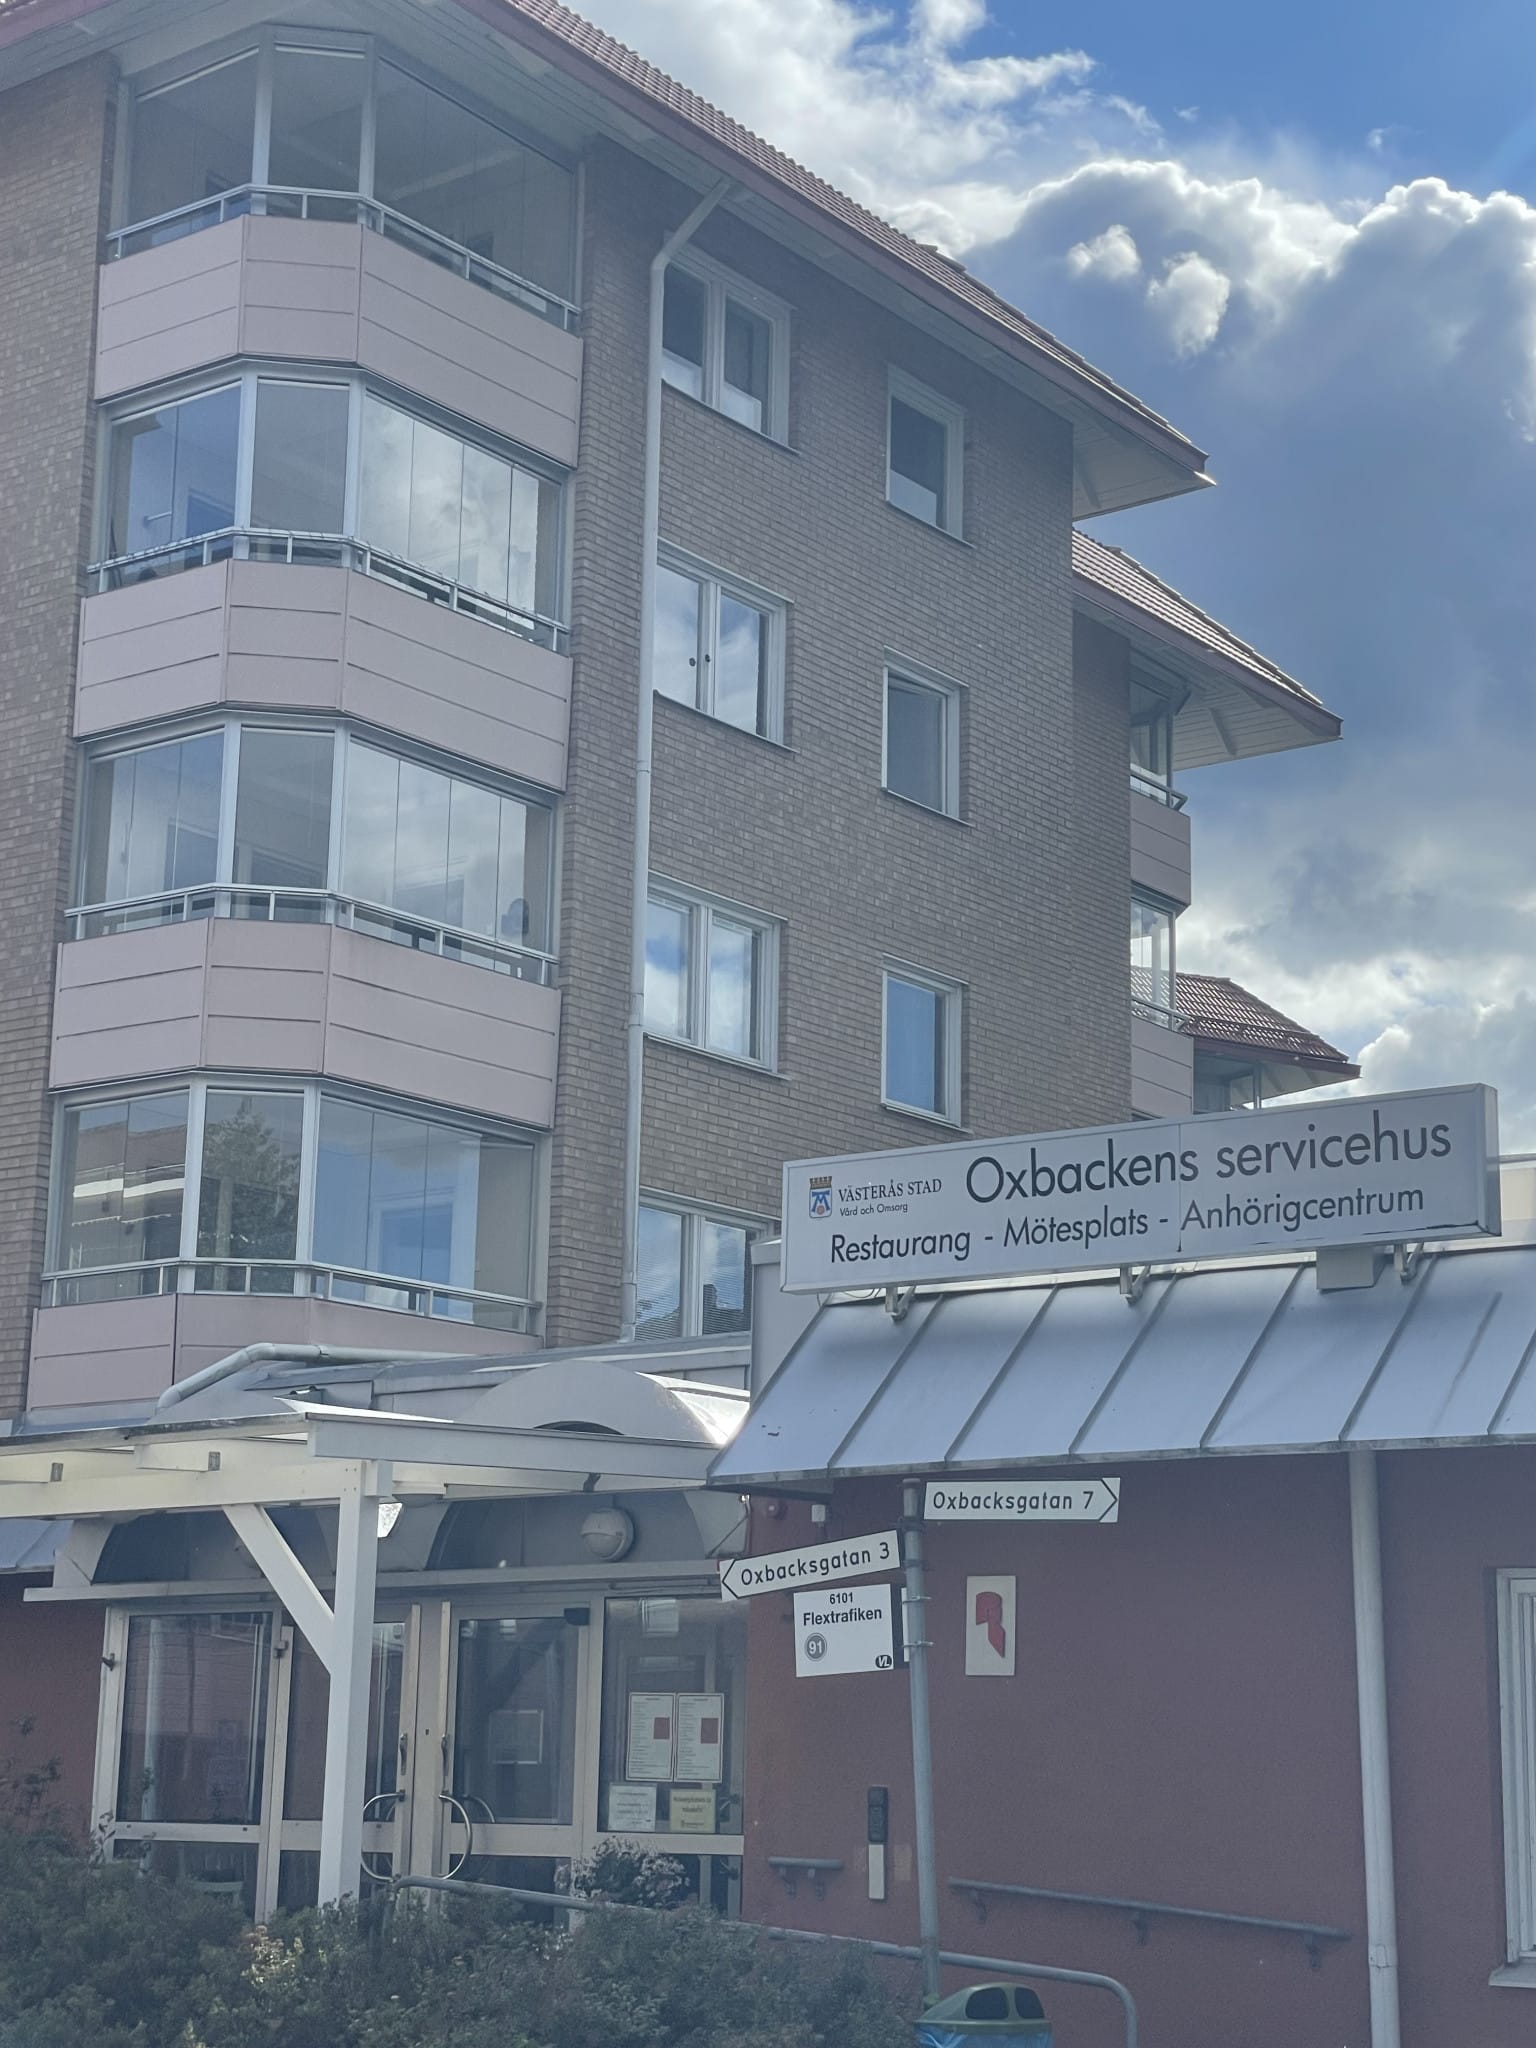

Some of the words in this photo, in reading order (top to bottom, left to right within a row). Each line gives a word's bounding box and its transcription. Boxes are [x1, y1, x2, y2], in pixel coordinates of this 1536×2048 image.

[966, 1138, 1199, 1203] Oxbackens
[1216, 1109, 1452, 1179] servicehus
[838, 1179, 904, 1203] VÄSTERÅS
[907, 1178, 942, 1196] STAD
[840, 1206, 858, 1217] Vård
[860, 1203, 875, 1215] och
[876, 1202, 908, 1214] Omsorg
[831, 1231, 971, 1263] Restaurang
[1003, 1204, 1149, 1249] Mötesplats
[1180, 1187, 1424, 1232] Anhörigcentrum
[933, 1490, 1073, 1515] Oxbacksgatan
[1082, 1490, 1094, 1510] 7
[740, 1547, 871, 1587] Oxbacksgatan
[878, 1541, 891, 1561] 3
[829, 1592, 854, 1605] 6101
[803, 1607, 882, 1627] Flextrafiken
[808, 1640, 822, 1655] 91
[878, 1656, 890, 1667] VL
